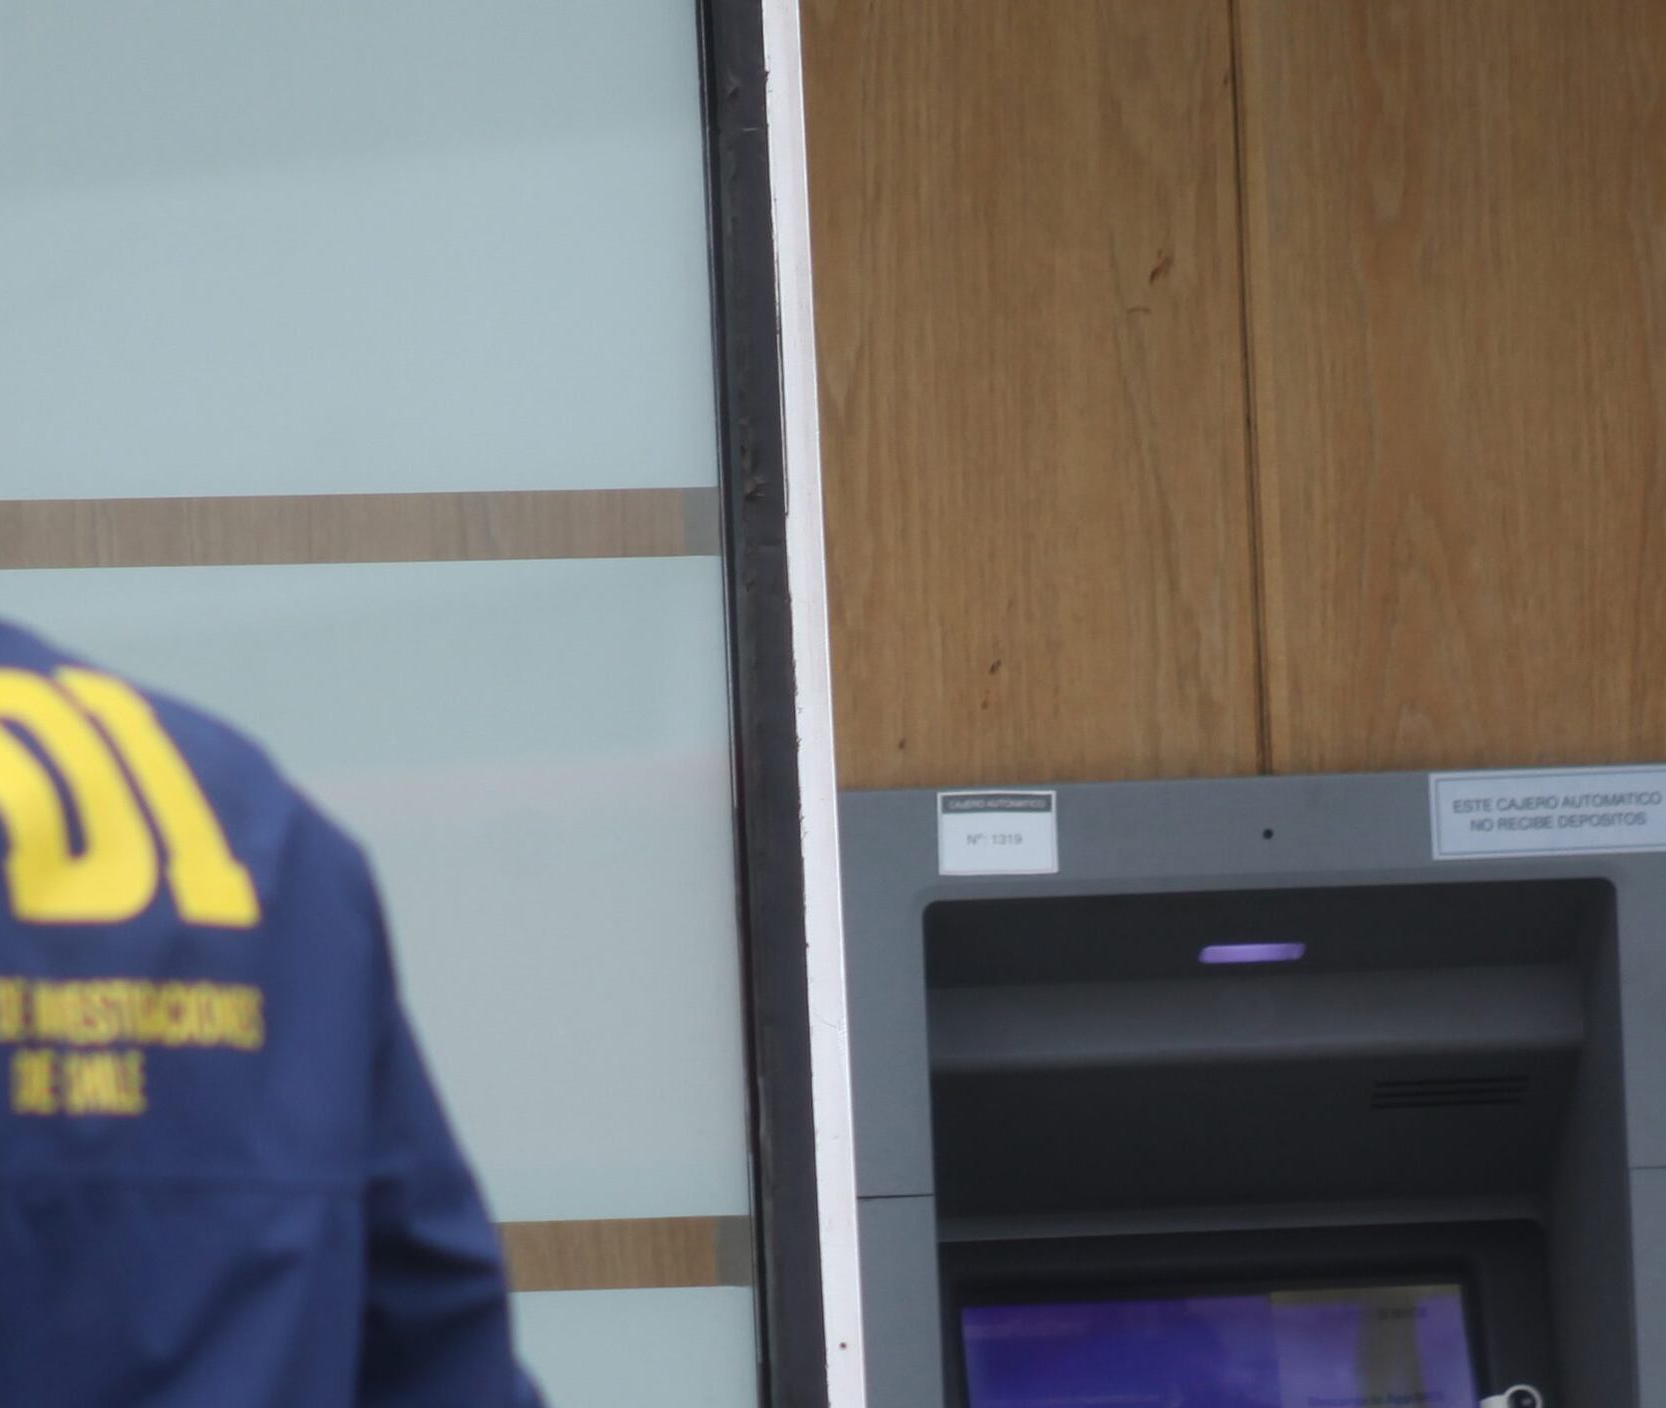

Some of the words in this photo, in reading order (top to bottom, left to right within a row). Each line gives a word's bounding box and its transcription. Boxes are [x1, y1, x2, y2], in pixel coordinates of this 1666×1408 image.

[1453, 798, 1493, 813] ESTE
[1496, 795, 1559, 812] CAJERO
[1561, 791, 1663, 809] AUTOMATICO
[1470, 818, 1494, 832] NO
[1497, 815, 1554, 831] RECIBE
[1557, 811, 1647, 829] DEPOSITOS
